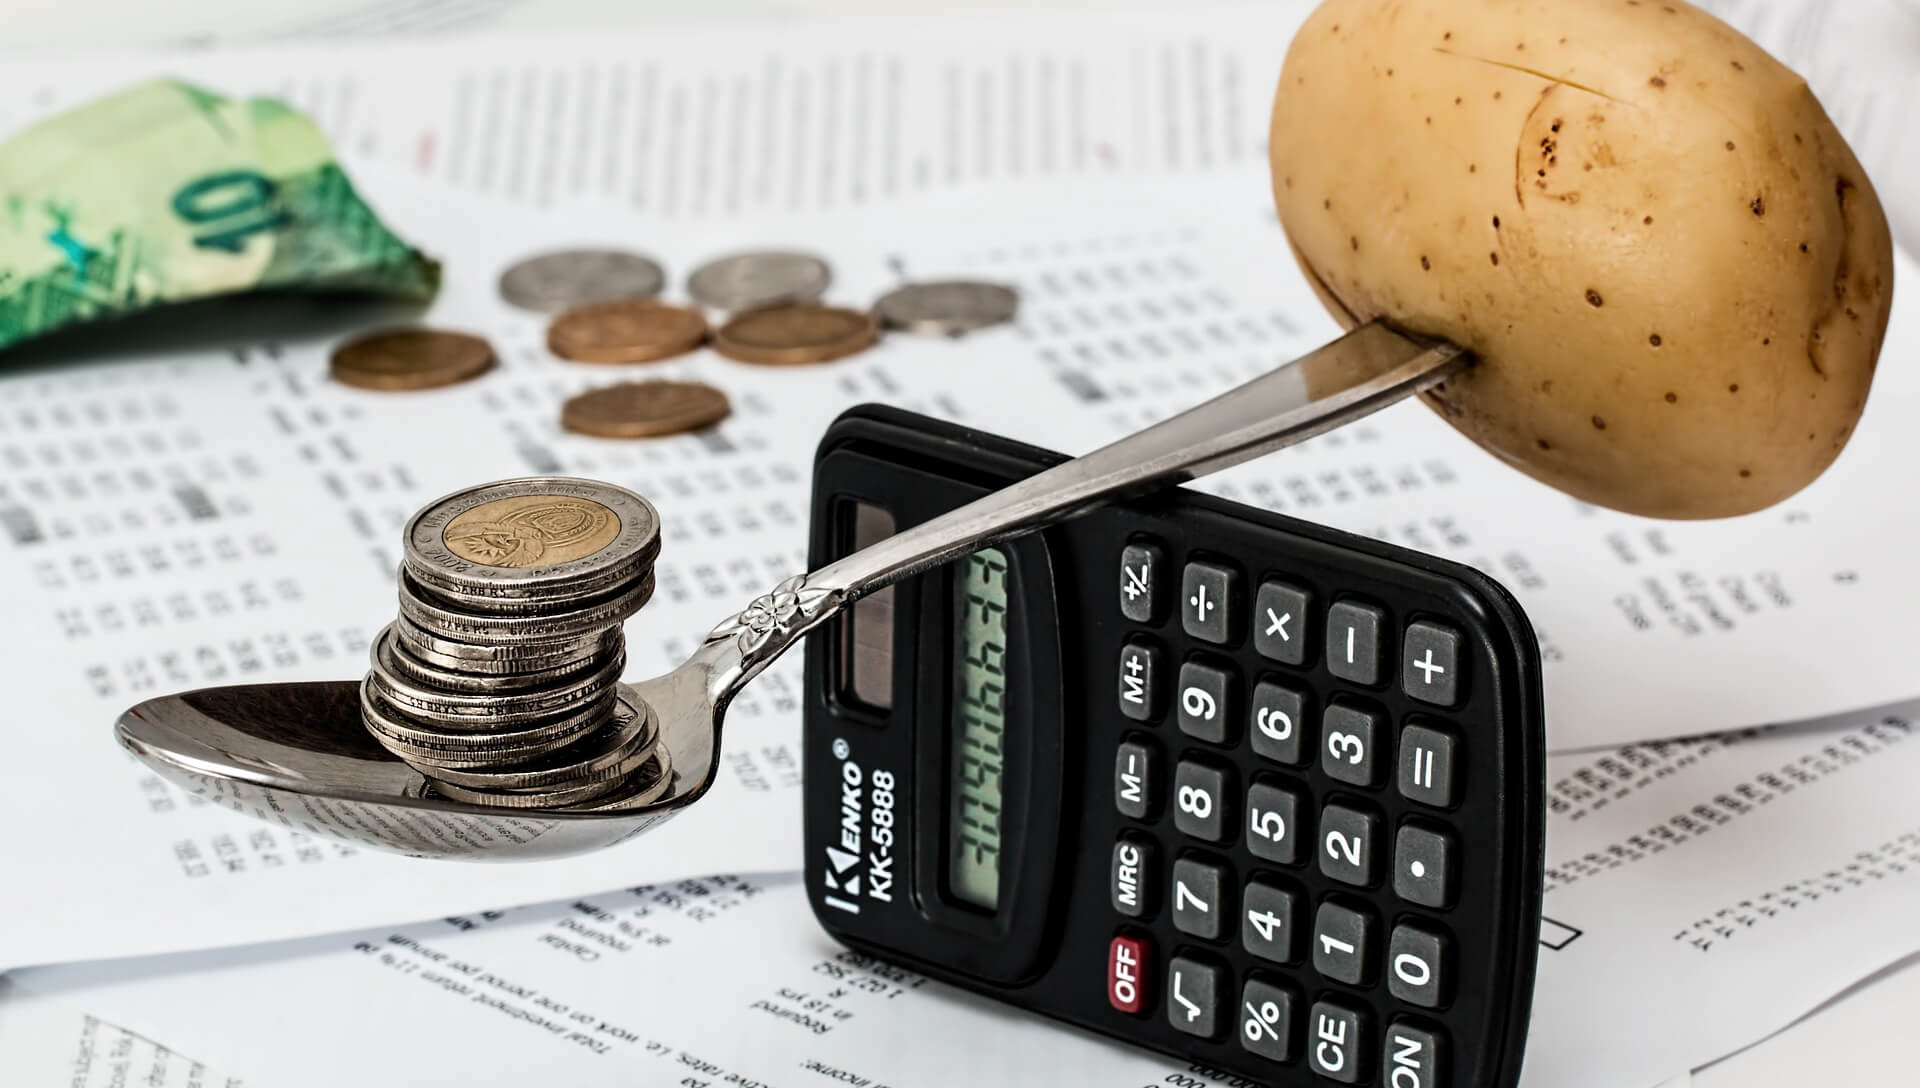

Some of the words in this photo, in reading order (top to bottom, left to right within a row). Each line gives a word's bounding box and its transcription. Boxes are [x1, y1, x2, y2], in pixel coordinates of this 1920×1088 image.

[173, 168, 294, 255] 10
[1123, 652, 1148, 704] M+
[1182, 686, 1216, 721] 9
[1257, 707, 1292, 741] 6
[1328, 731, 1364, 765] 3
[1178, 785, 1212, 819] 8
[869, 769, 895, 902] KK-5888
[1251, 807, 1285, 842] 5
[1325, 830, 1361, 867] 2
[1118, 844, 1139, 906] MRC
[1176, 880, 1209, 913] 7
[1248, 909, 1281, 942] 4
[1319, 933, 1355, 955] 1
[419, 970, 476, 997] return
[447, 960, 483, 976] per
[1114, 944, 1137, 1004] OFF
[1394, 953, 1431, 986] 0
[473, 972, 538, 999] period
[471, 992, 568, 1036] investment
[532, 996, 571, 1015] one
[568, 1010, 597, 1026] on
[749, 1000, 834, 1035] Required
[563, 1031, 613, 1056] Total
[595, 1020, 641, 1045] work
[1316, 1014, 1347, 1072] CE
[1391, 1035, 1422, 1088] ON
